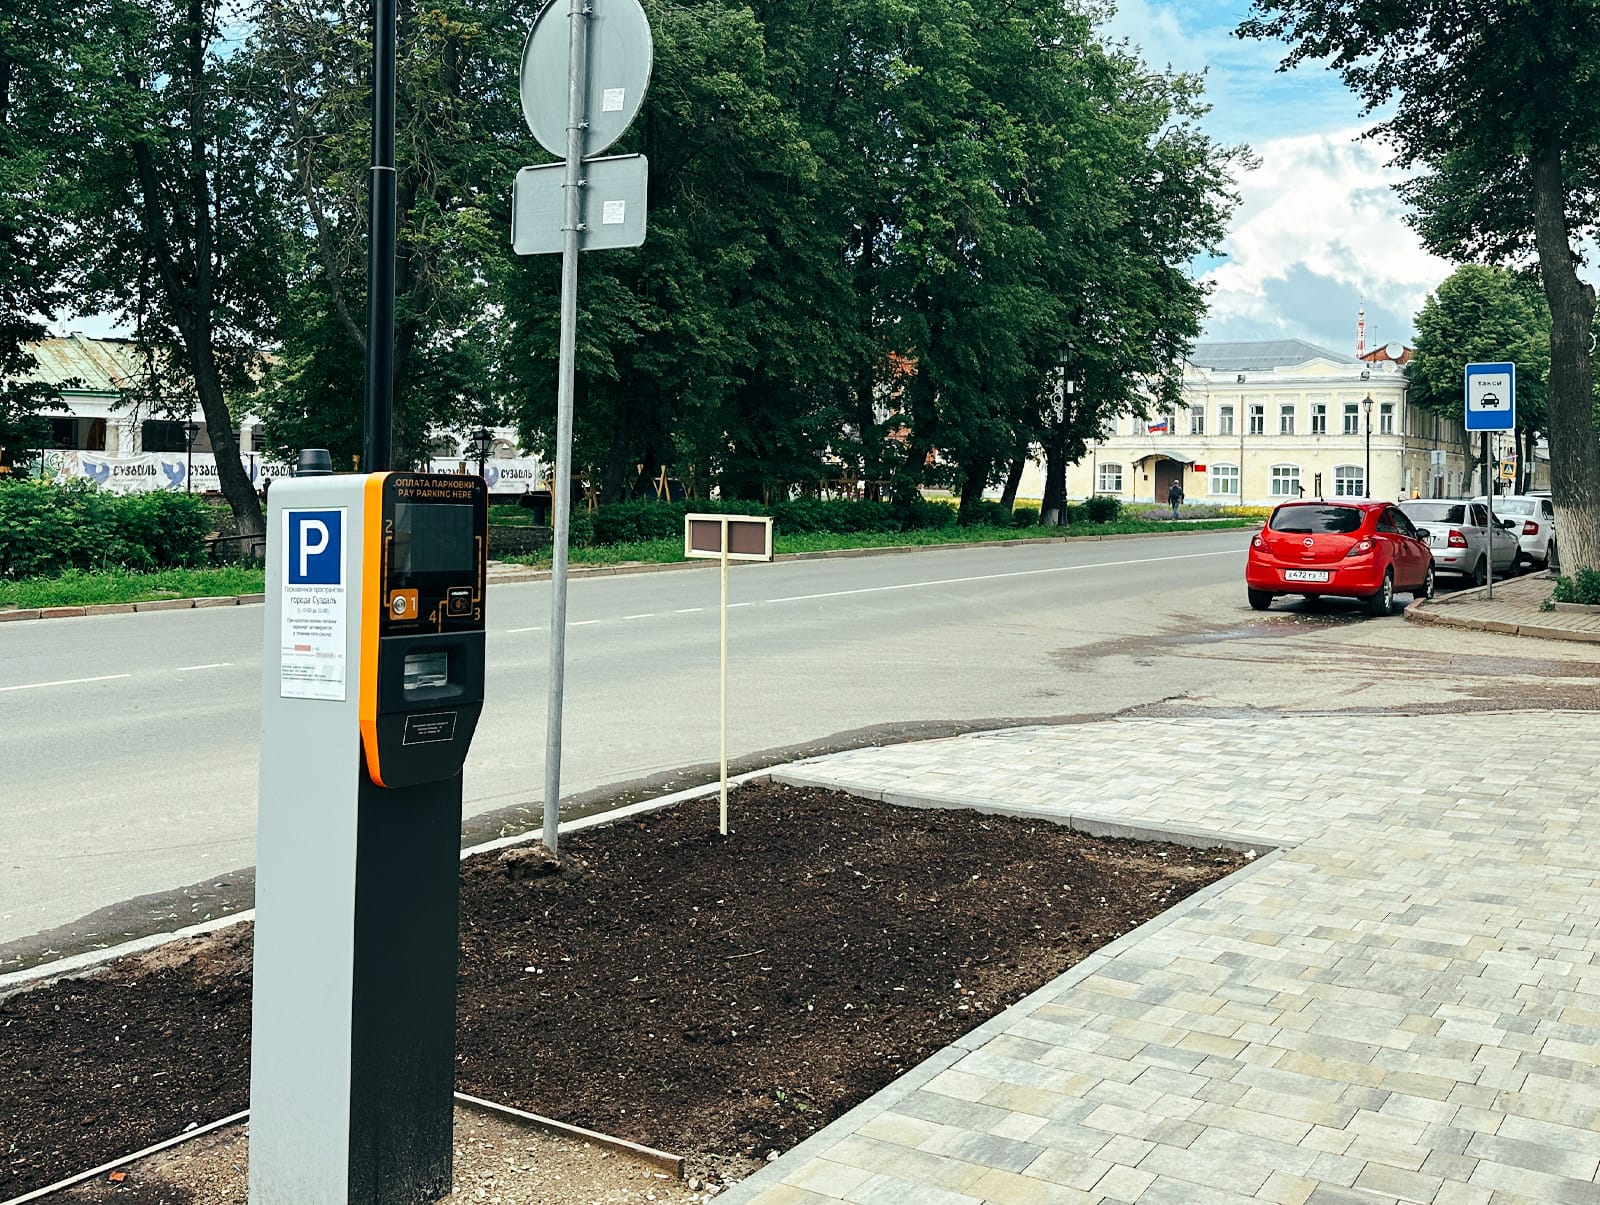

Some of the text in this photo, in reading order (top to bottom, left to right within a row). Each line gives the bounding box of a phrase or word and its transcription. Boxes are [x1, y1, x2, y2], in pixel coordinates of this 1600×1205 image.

[260, 465, 291, 477] СУЗДАЛ
[395, 478, 475, 489] ОПЛАТА ПАРКОВКИ
[398, 489, 473, 498] PAY PARKING HERE
[385, 519, 393, 534] 2
[300, 519, 329, 577] P
[410, 596, 416, 611] 1
[429, 610, 437, 624] 4
[474, 607, 481, 621] 3
